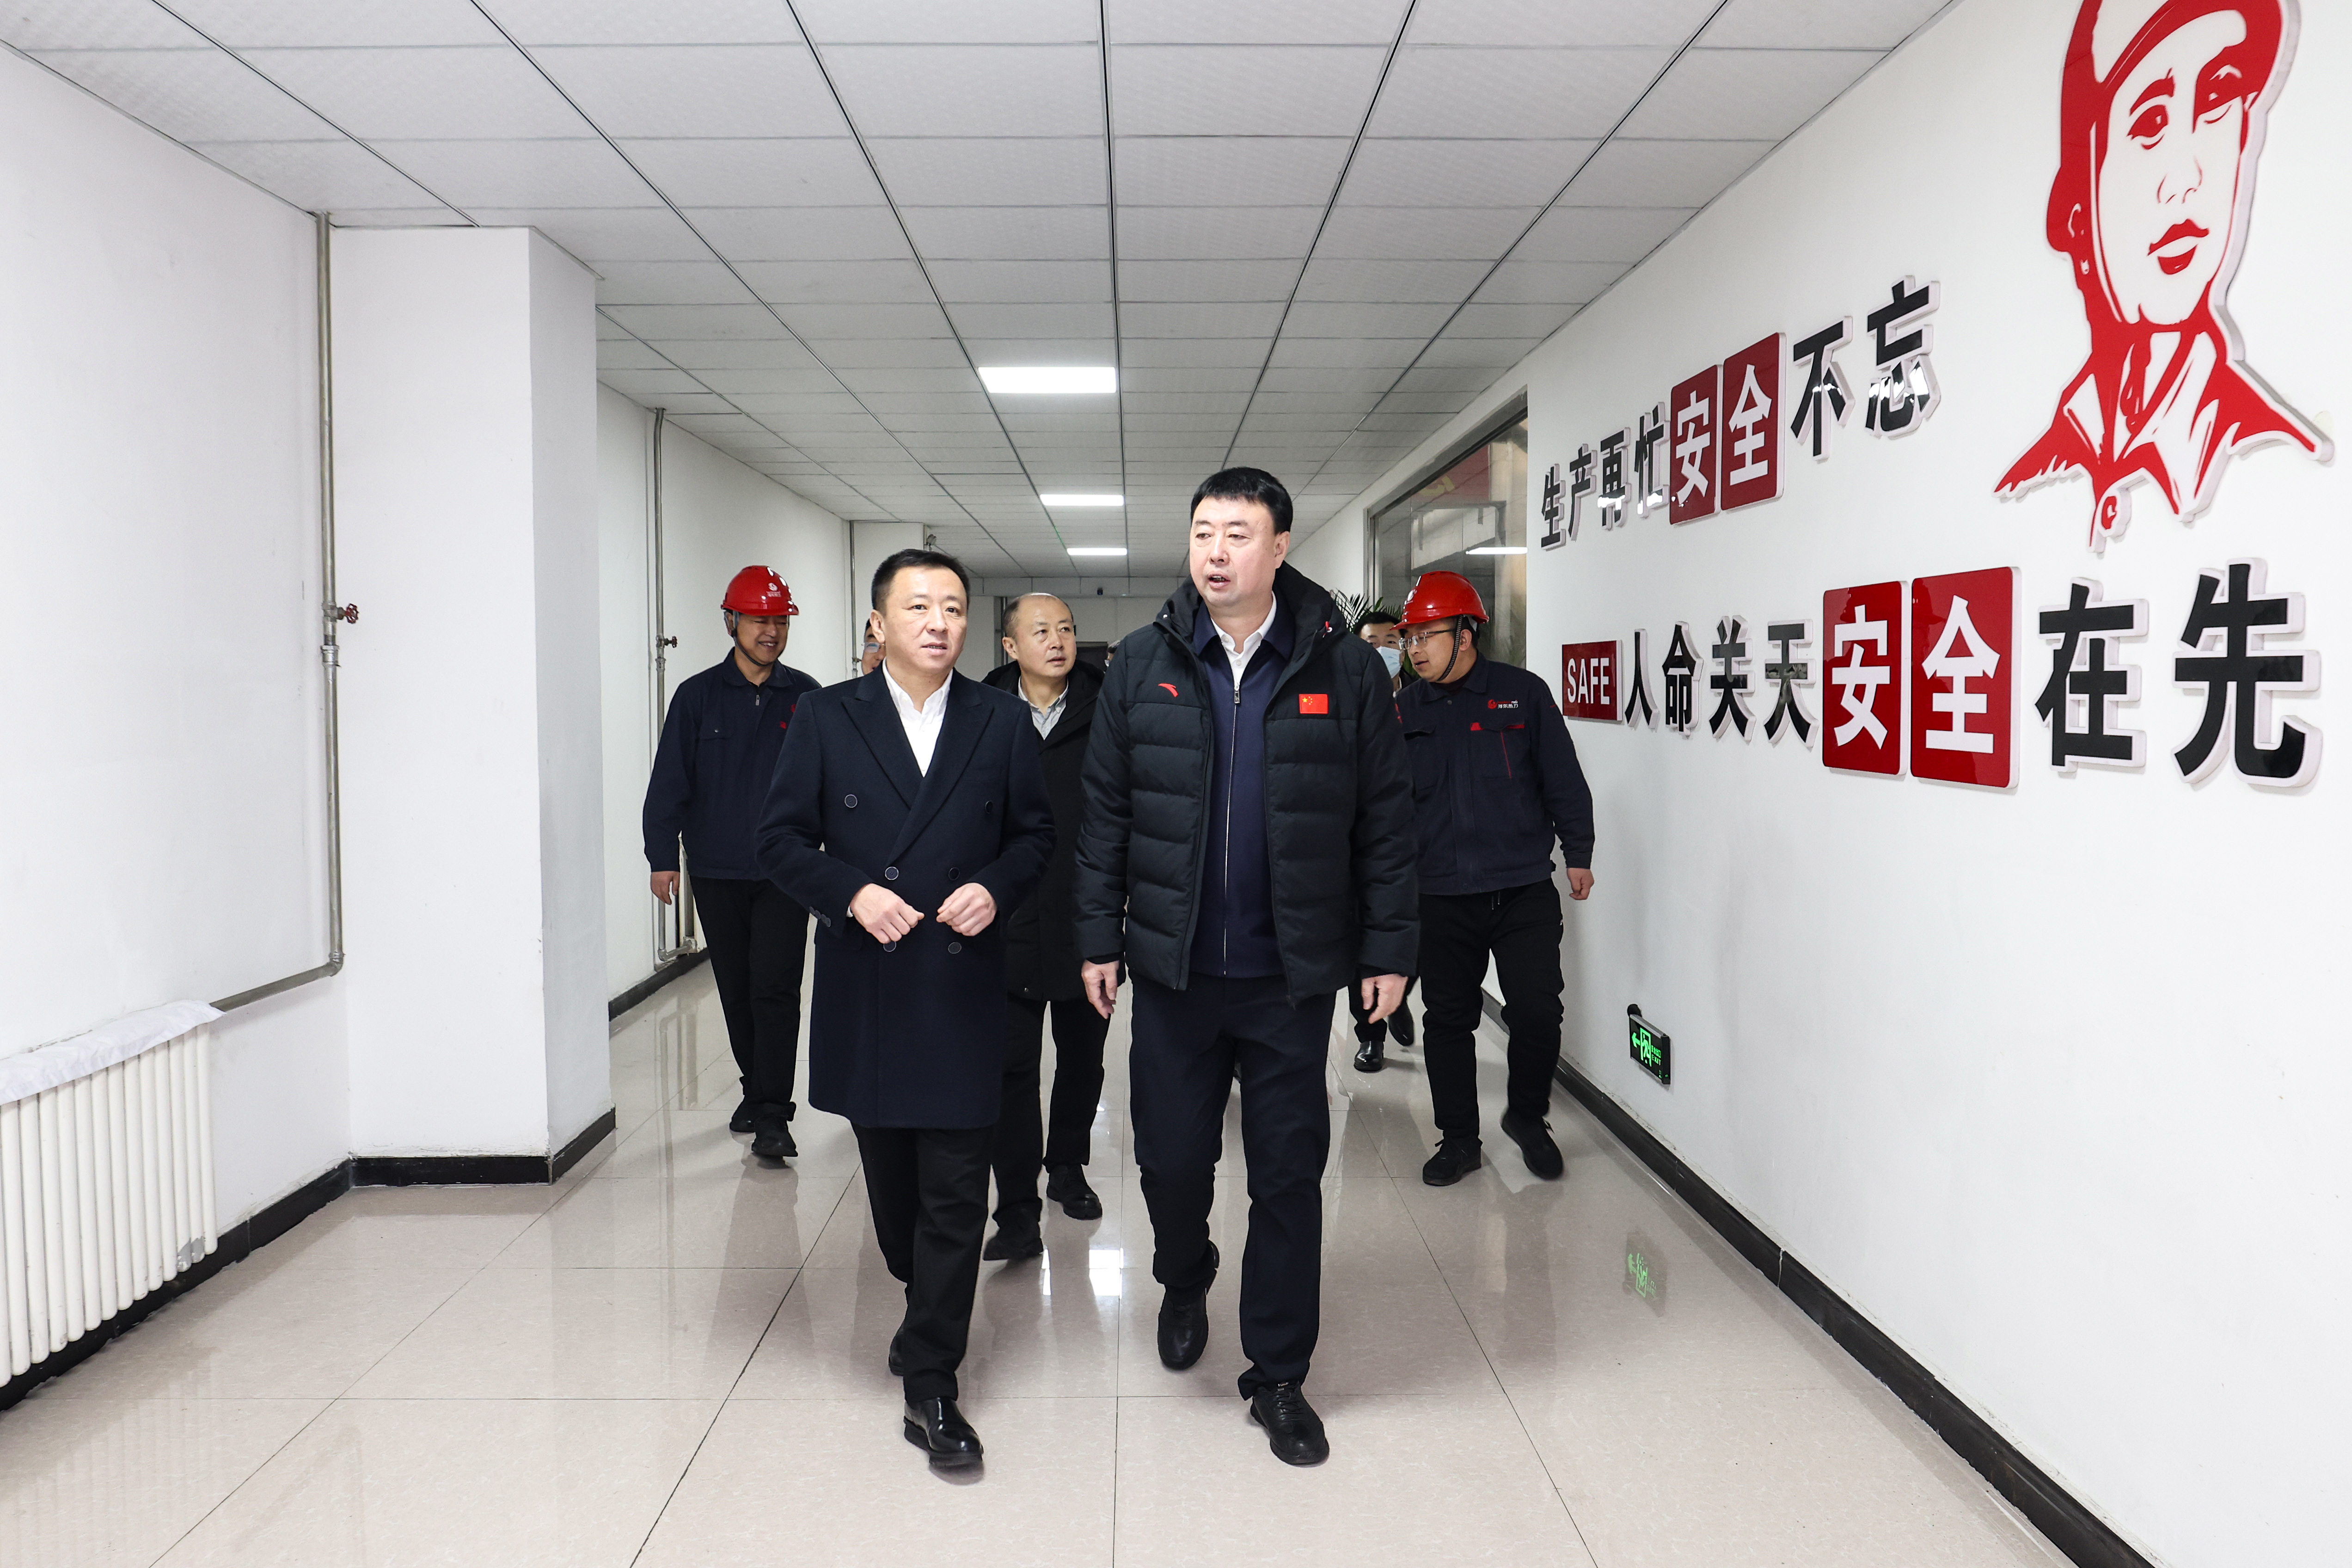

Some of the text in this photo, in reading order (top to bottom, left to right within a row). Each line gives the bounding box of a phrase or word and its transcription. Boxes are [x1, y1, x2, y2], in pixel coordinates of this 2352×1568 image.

[1541, 278, 1937, 548] 生产再忙安全不忘
[1568, 562, 2311, 781] SAFE 人命关天安全在先
[1652, 1054, 1661, 1066] EXIT
